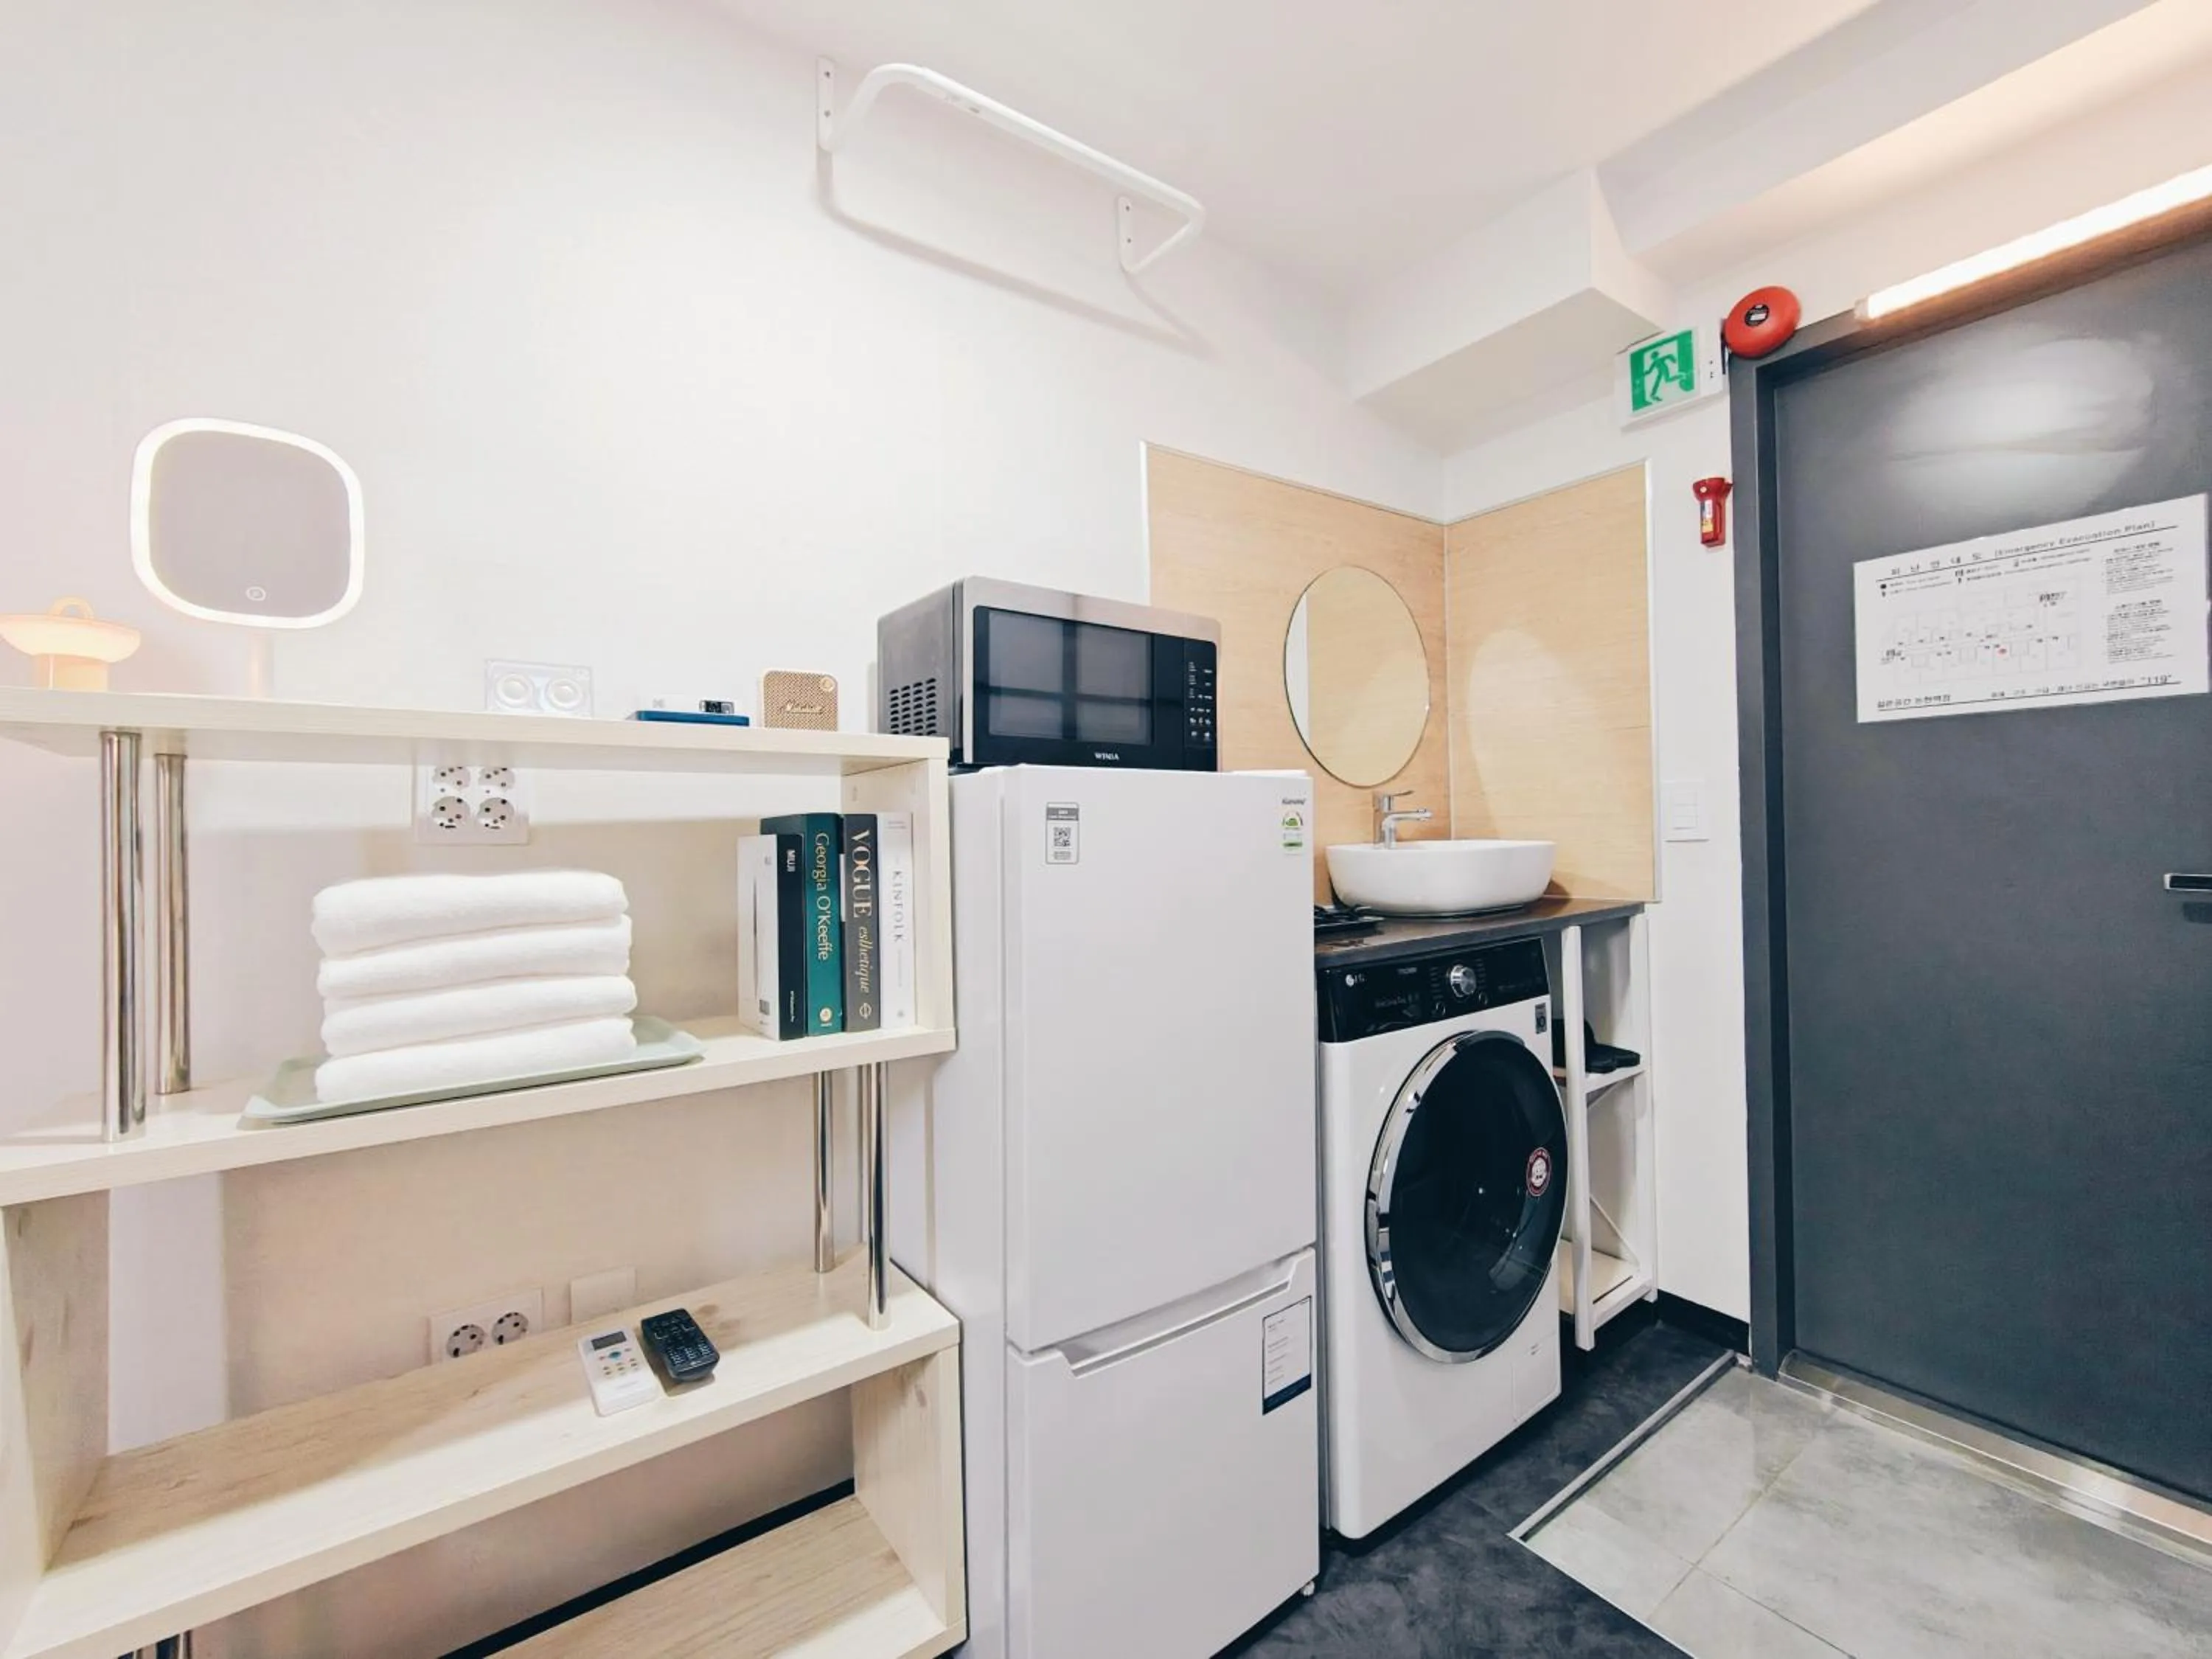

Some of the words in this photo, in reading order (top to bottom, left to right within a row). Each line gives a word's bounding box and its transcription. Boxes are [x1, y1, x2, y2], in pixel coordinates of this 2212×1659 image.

[812, 832, 831, 891] Georgia
[851, 830, 872, 918] VOGUE
[816, 895, 832, 961] O'Keeffe
